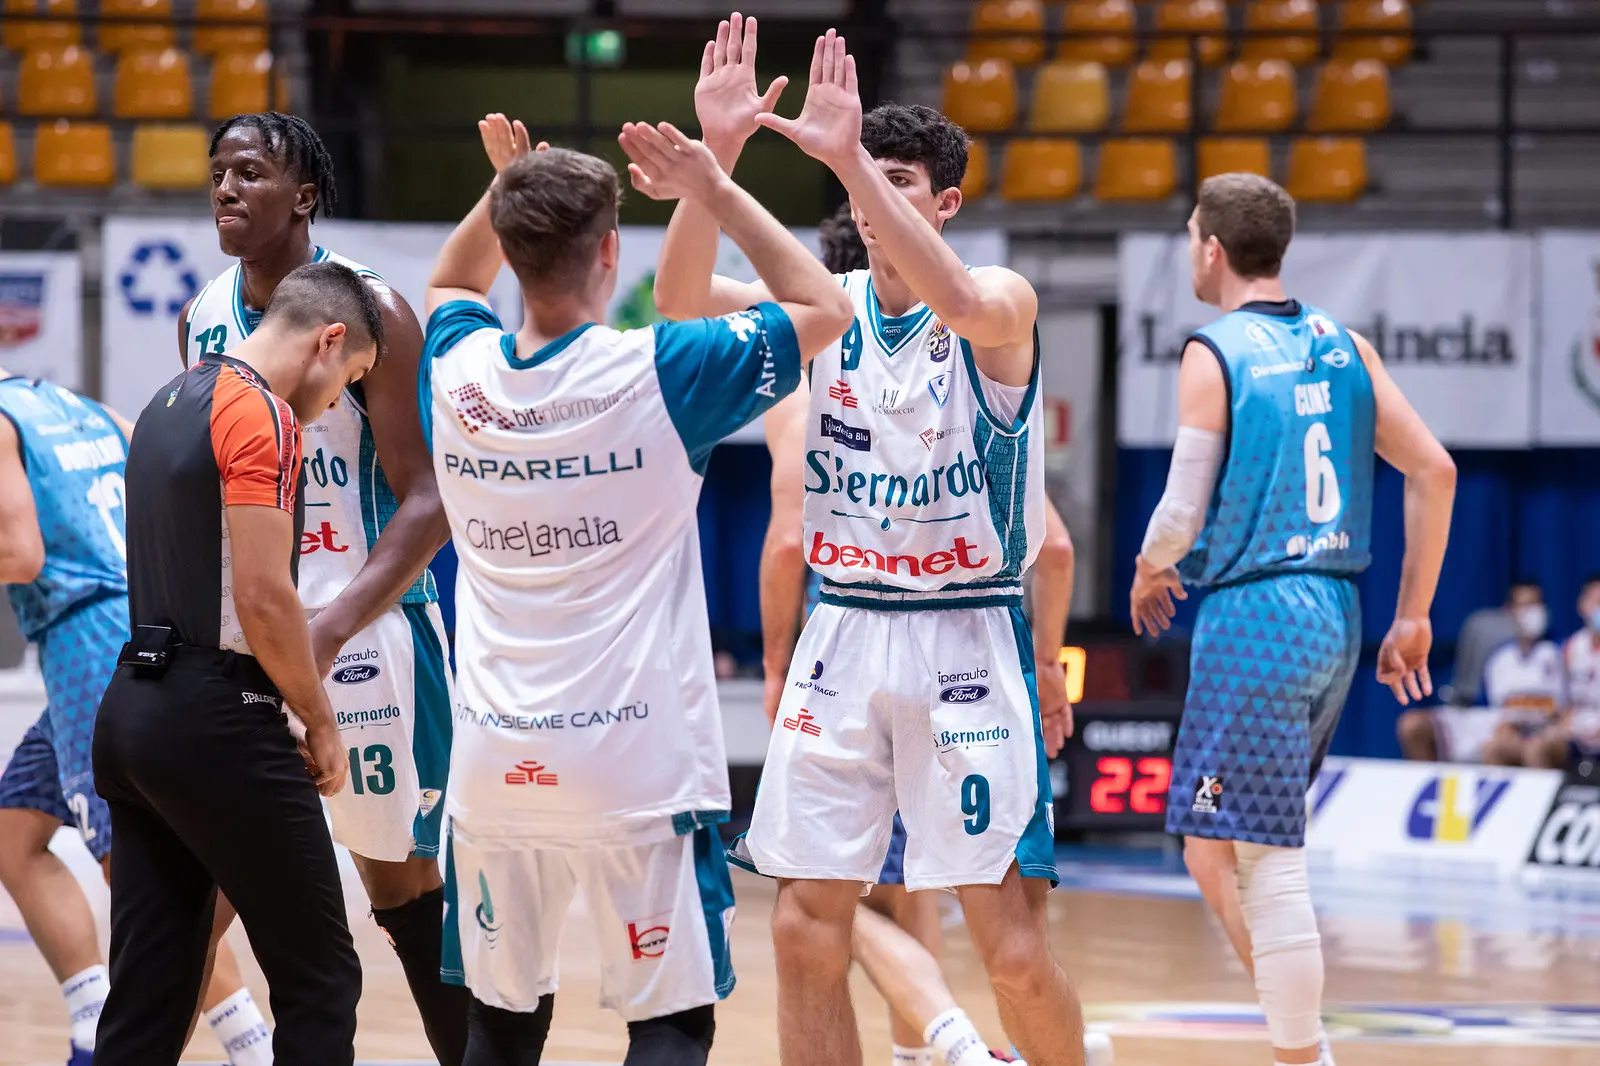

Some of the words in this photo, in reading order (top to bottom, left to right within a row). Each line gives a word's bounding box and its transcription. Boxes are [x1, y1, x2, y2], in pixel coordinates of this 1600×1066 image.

[933, 340, 949, 355] LBA
[855, 432, 869, 442] Blu
[444, 447, 644, 481] PAPARELLI
[1303, 423, 1341, 524] 6
[809, 531, 990, 577] bennet
[333, 648, 379, 668] perauto
[341, 667, 371, 682] Ford
[937, 667, 989, 686] iperauto
[948, 687, 979, 701] Ford
[336, 703, 401, 726] Bernardo
[480, 711, 565, 730] INSIEME
[570, 701, 649, 728] CANTÙ
[349, 744, 397, 796] 13
[1090, 756, 1173, 814] 22
[960, 773, 991, 836] 9
